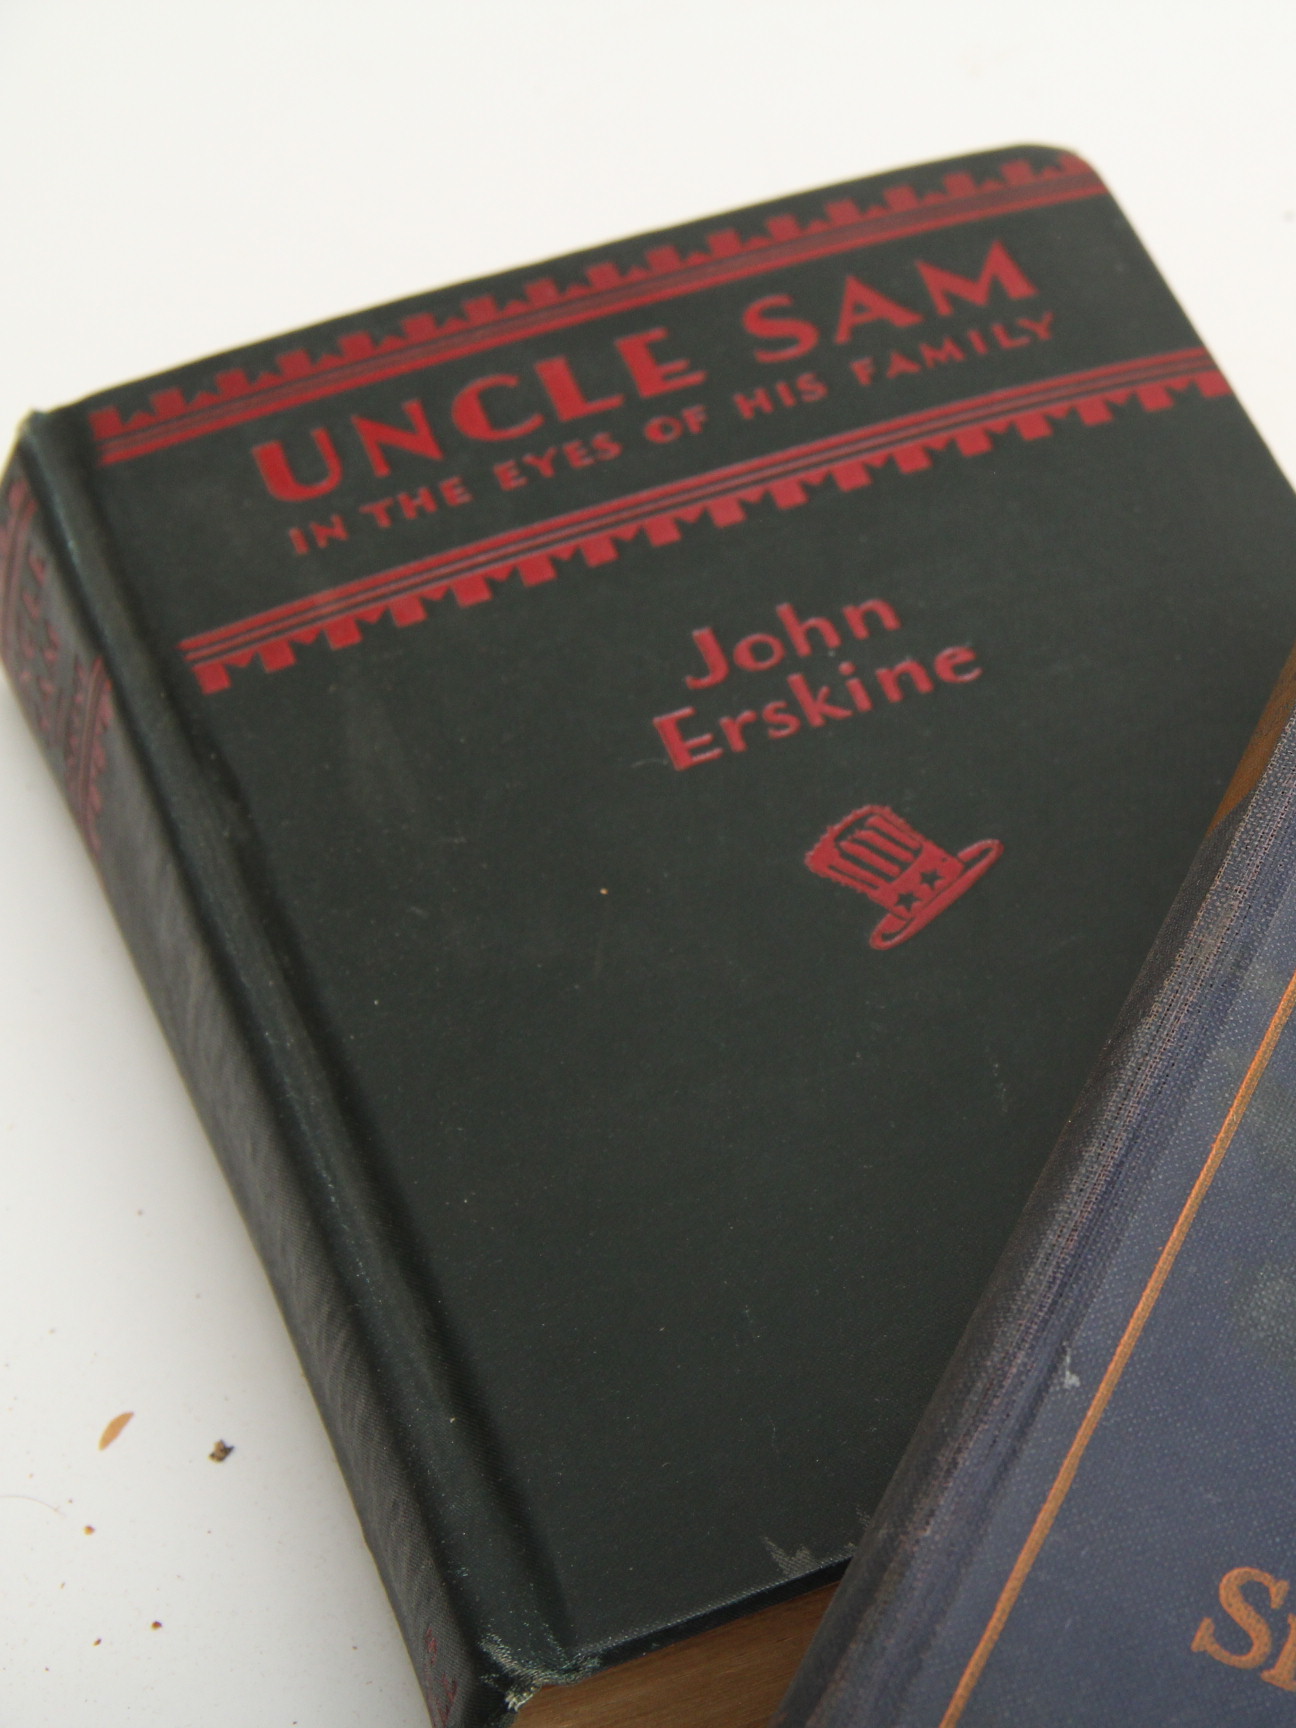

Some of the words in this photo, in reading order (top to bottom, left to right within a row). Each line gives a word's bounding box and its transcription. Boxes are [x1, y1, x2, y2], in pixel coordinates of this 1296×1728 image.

[252, 328, 706, 503] UNCLE
[742, 240, 1037, 364] SAM
[288, 515, 349, 554] IN
[360, 477, 471, 527] THE
[494, 433, 623, 490] EYES
[644, 406, 709, 443] OF
[734, 374, 828, 419] HIS
[850, 312, 1055, 386] FAMILY
[652, 641, 982, 771] Erskine
[684, 599, 902, 690] John
